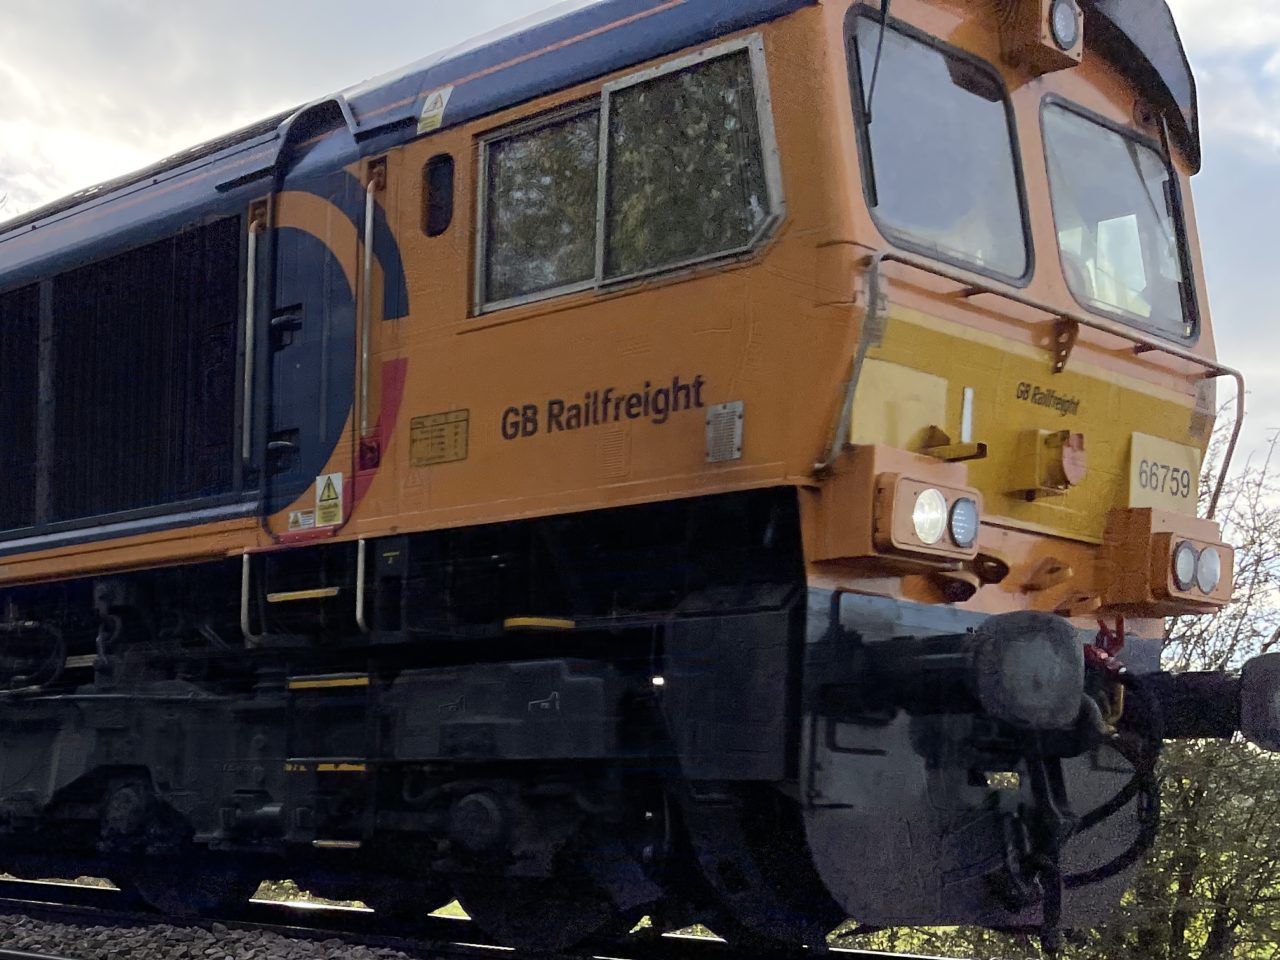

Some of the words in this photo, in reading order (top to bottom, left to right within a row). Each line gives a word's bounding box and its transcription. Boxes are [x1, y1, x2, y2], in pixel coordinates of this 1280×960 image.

[501, 403, 539, 440] GB
[546, 375, 705, 433] Railfreight
[1016, 382, 1031, 401] GB
[1031, 386, 1080, 417] Railfreight
[1139, 459, 1190, 499] 66759
